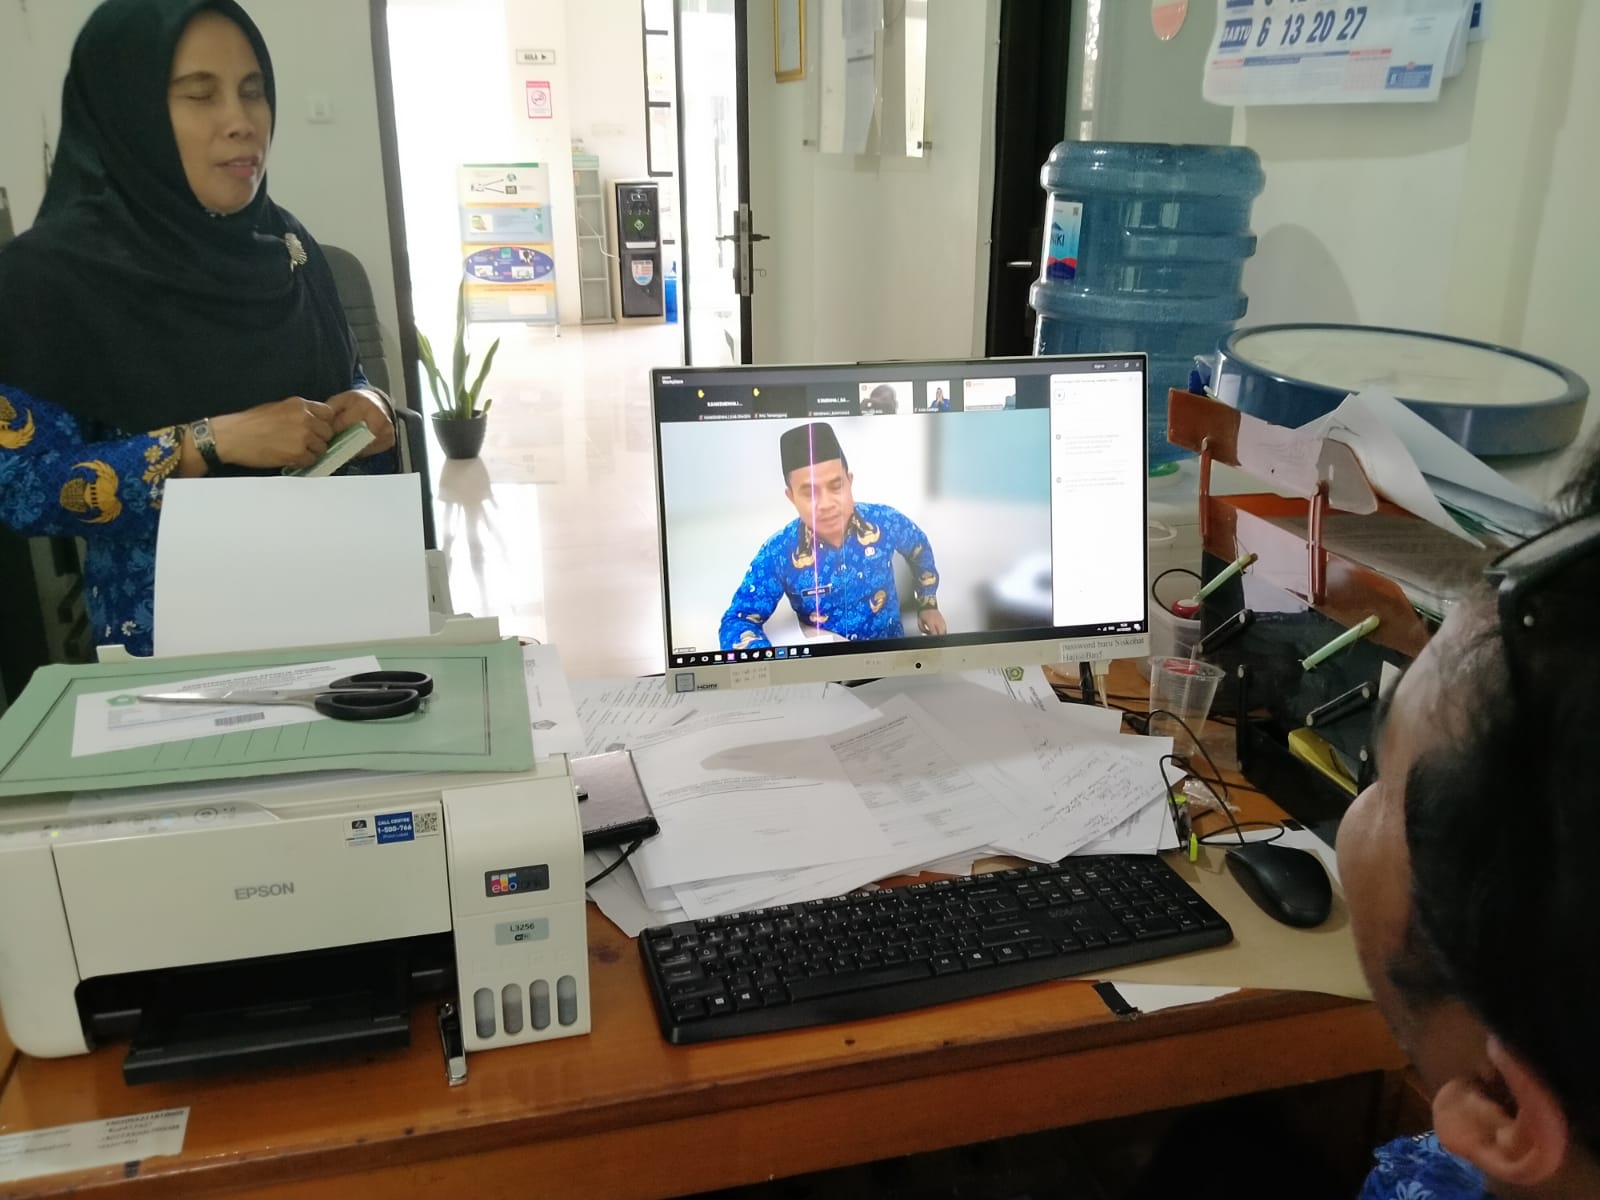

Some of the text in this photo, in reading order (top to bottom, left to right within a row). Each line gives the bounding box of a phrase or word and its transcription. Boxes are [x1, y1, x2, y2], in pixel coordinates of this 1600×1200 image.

[1222, 24, 1252, 42] SABTU
[1257, 16, 1272, 47] 6
[1280, 13, 1305, 46] 13
[1306, 9, 1336, 43] 20
[1336, 6, 1368, 41] 27
[377, 824, 412, 834] 1-500-766
[234, 881, 295, 901] EPSON
[510, 922, 535, 932] L3256
